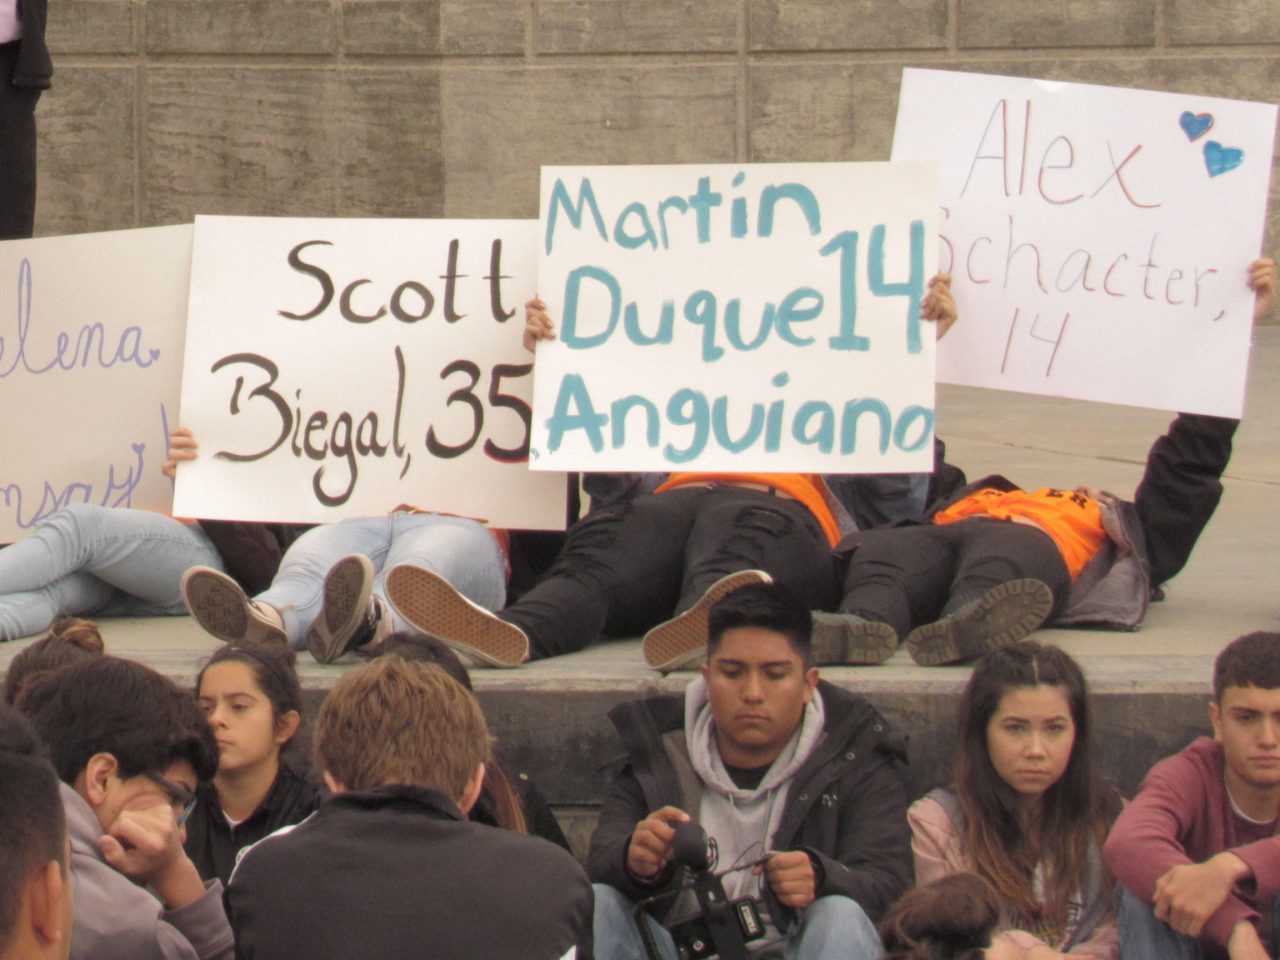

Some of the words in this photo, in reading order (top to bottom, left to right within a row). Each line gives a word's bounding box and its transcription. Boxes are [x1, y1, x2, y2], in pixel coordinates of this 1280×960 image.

[959, 98, 1161, 208] Alex
[545, 171, 823, 256] Martin
[277, 239, 517, 324] Scott
[560, 265, 824, 363] Duque
[818, 220, 926, 355] 14
[1000, 307, 1070, 378] 14
[210, 345, 411, 508] Biegal,
[425, 359, 534, 464] 35
[544, 371, 935, 464] Anguiano
